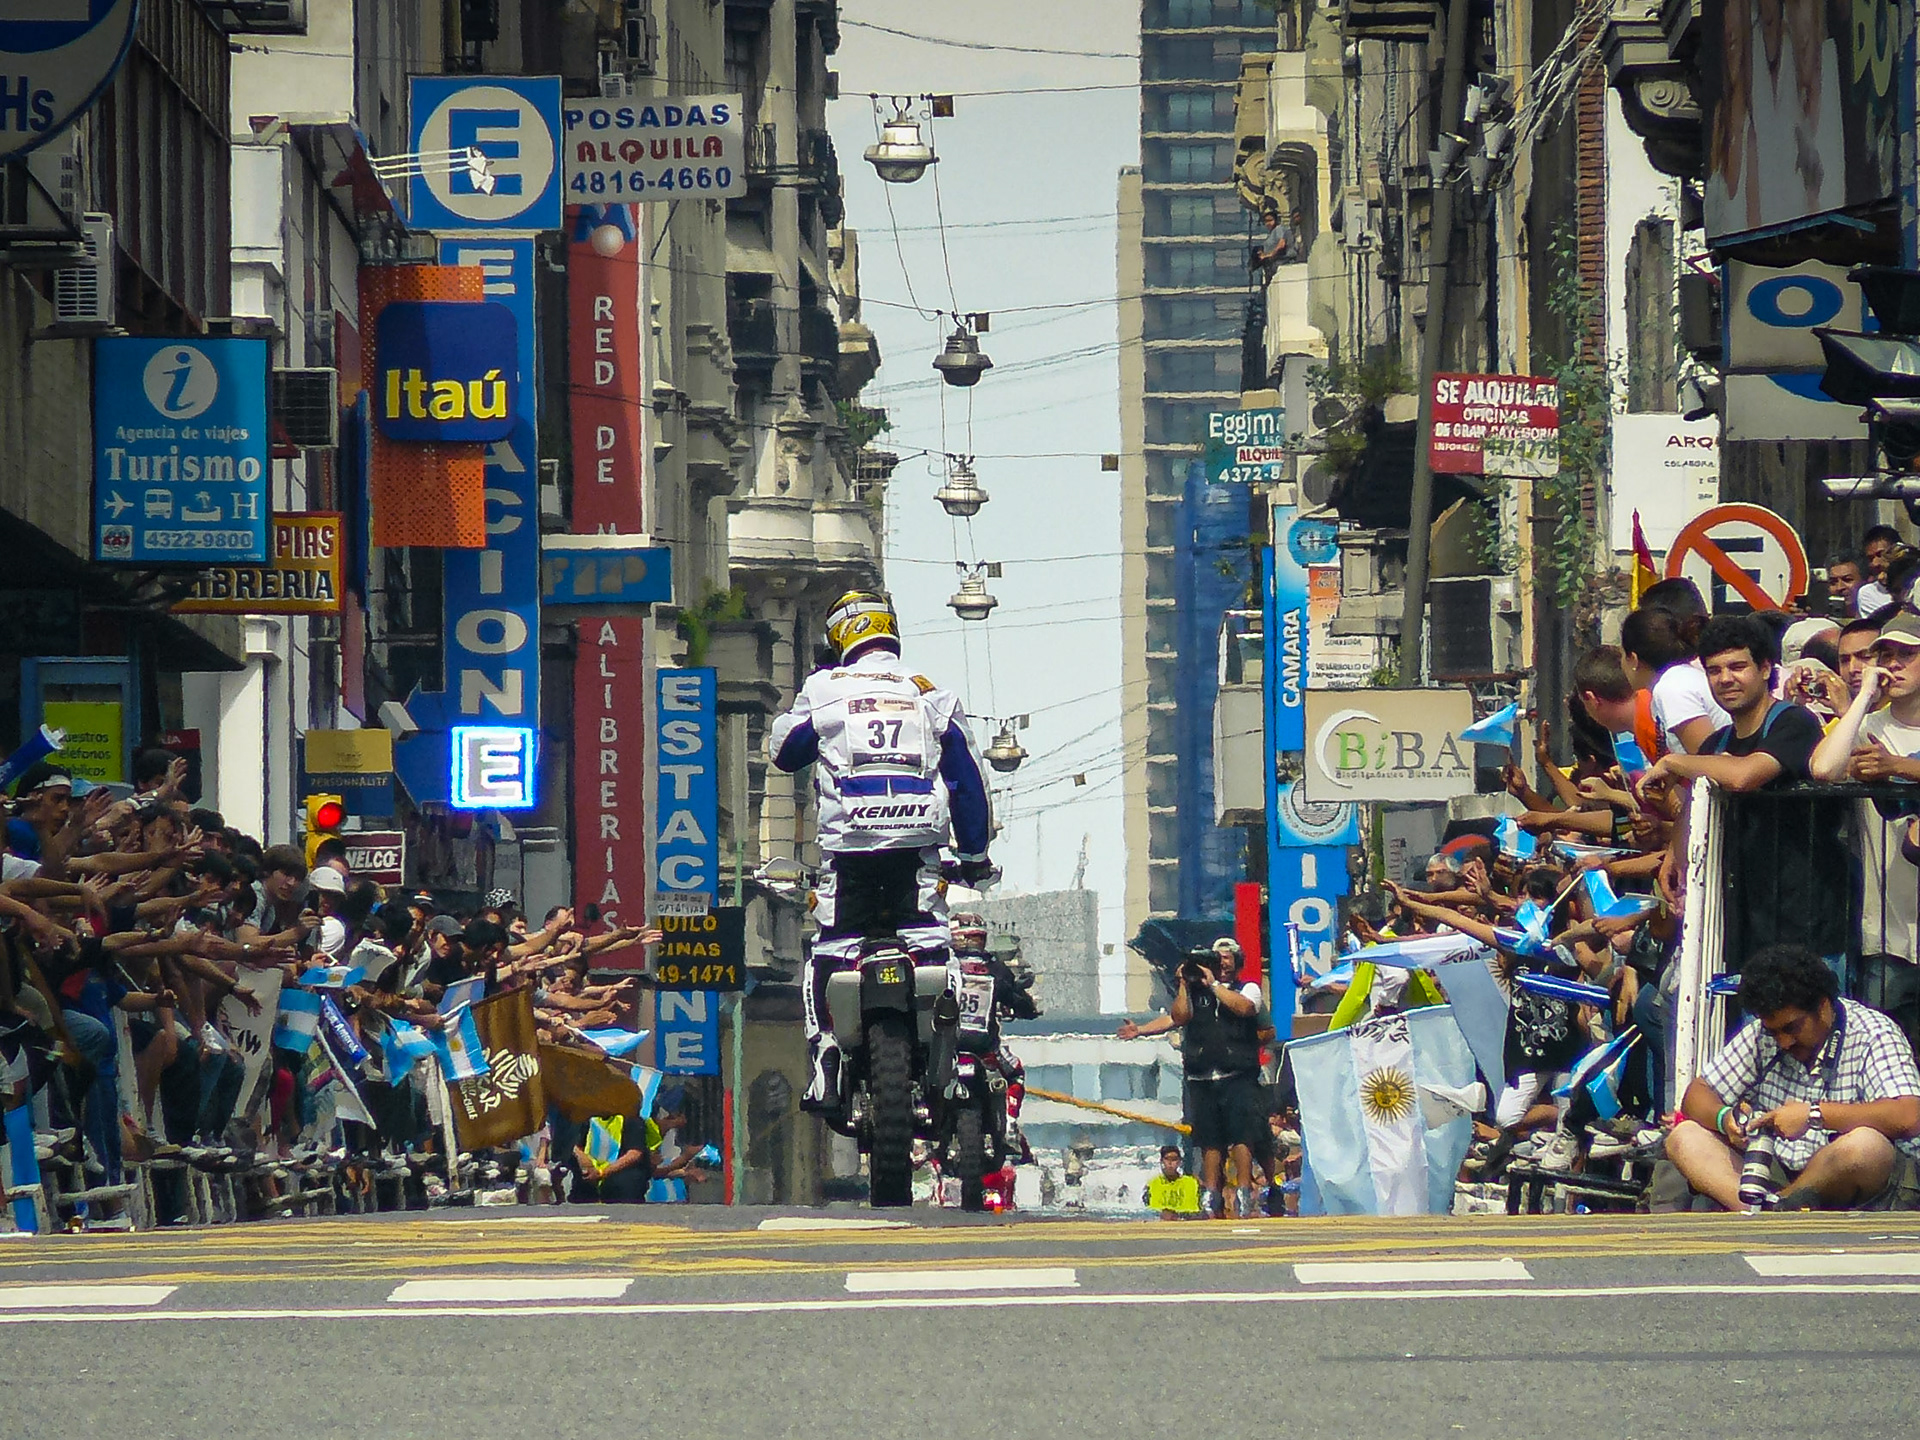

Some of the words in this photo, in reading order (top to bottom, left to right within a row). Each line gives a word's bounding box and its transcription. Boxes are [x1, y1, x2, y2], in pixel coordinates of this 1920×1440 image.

[566, 103, 731, 132] POSADAS
[576, 135, 725, 165] ALQUILA
[571, 167, 732, 195] 4816-4660
[385, 369, 507, 420] Itaú
[1436, 379, 1461, 404] SE
[1463, 407, 1530, 425] OFICINAS
[115, 425, 176, 444] Agencia
[181, 425, 199, 440] de
[204, 425, 249, 444] viajes
[104, 445, 261, 483] Turismo
[146, 531, 252, 548] 4322-9800
[63, 731, 109, 744] uestros
[868, 719, 903, 748] 37
[848, 803, 931, 820] KENNY
